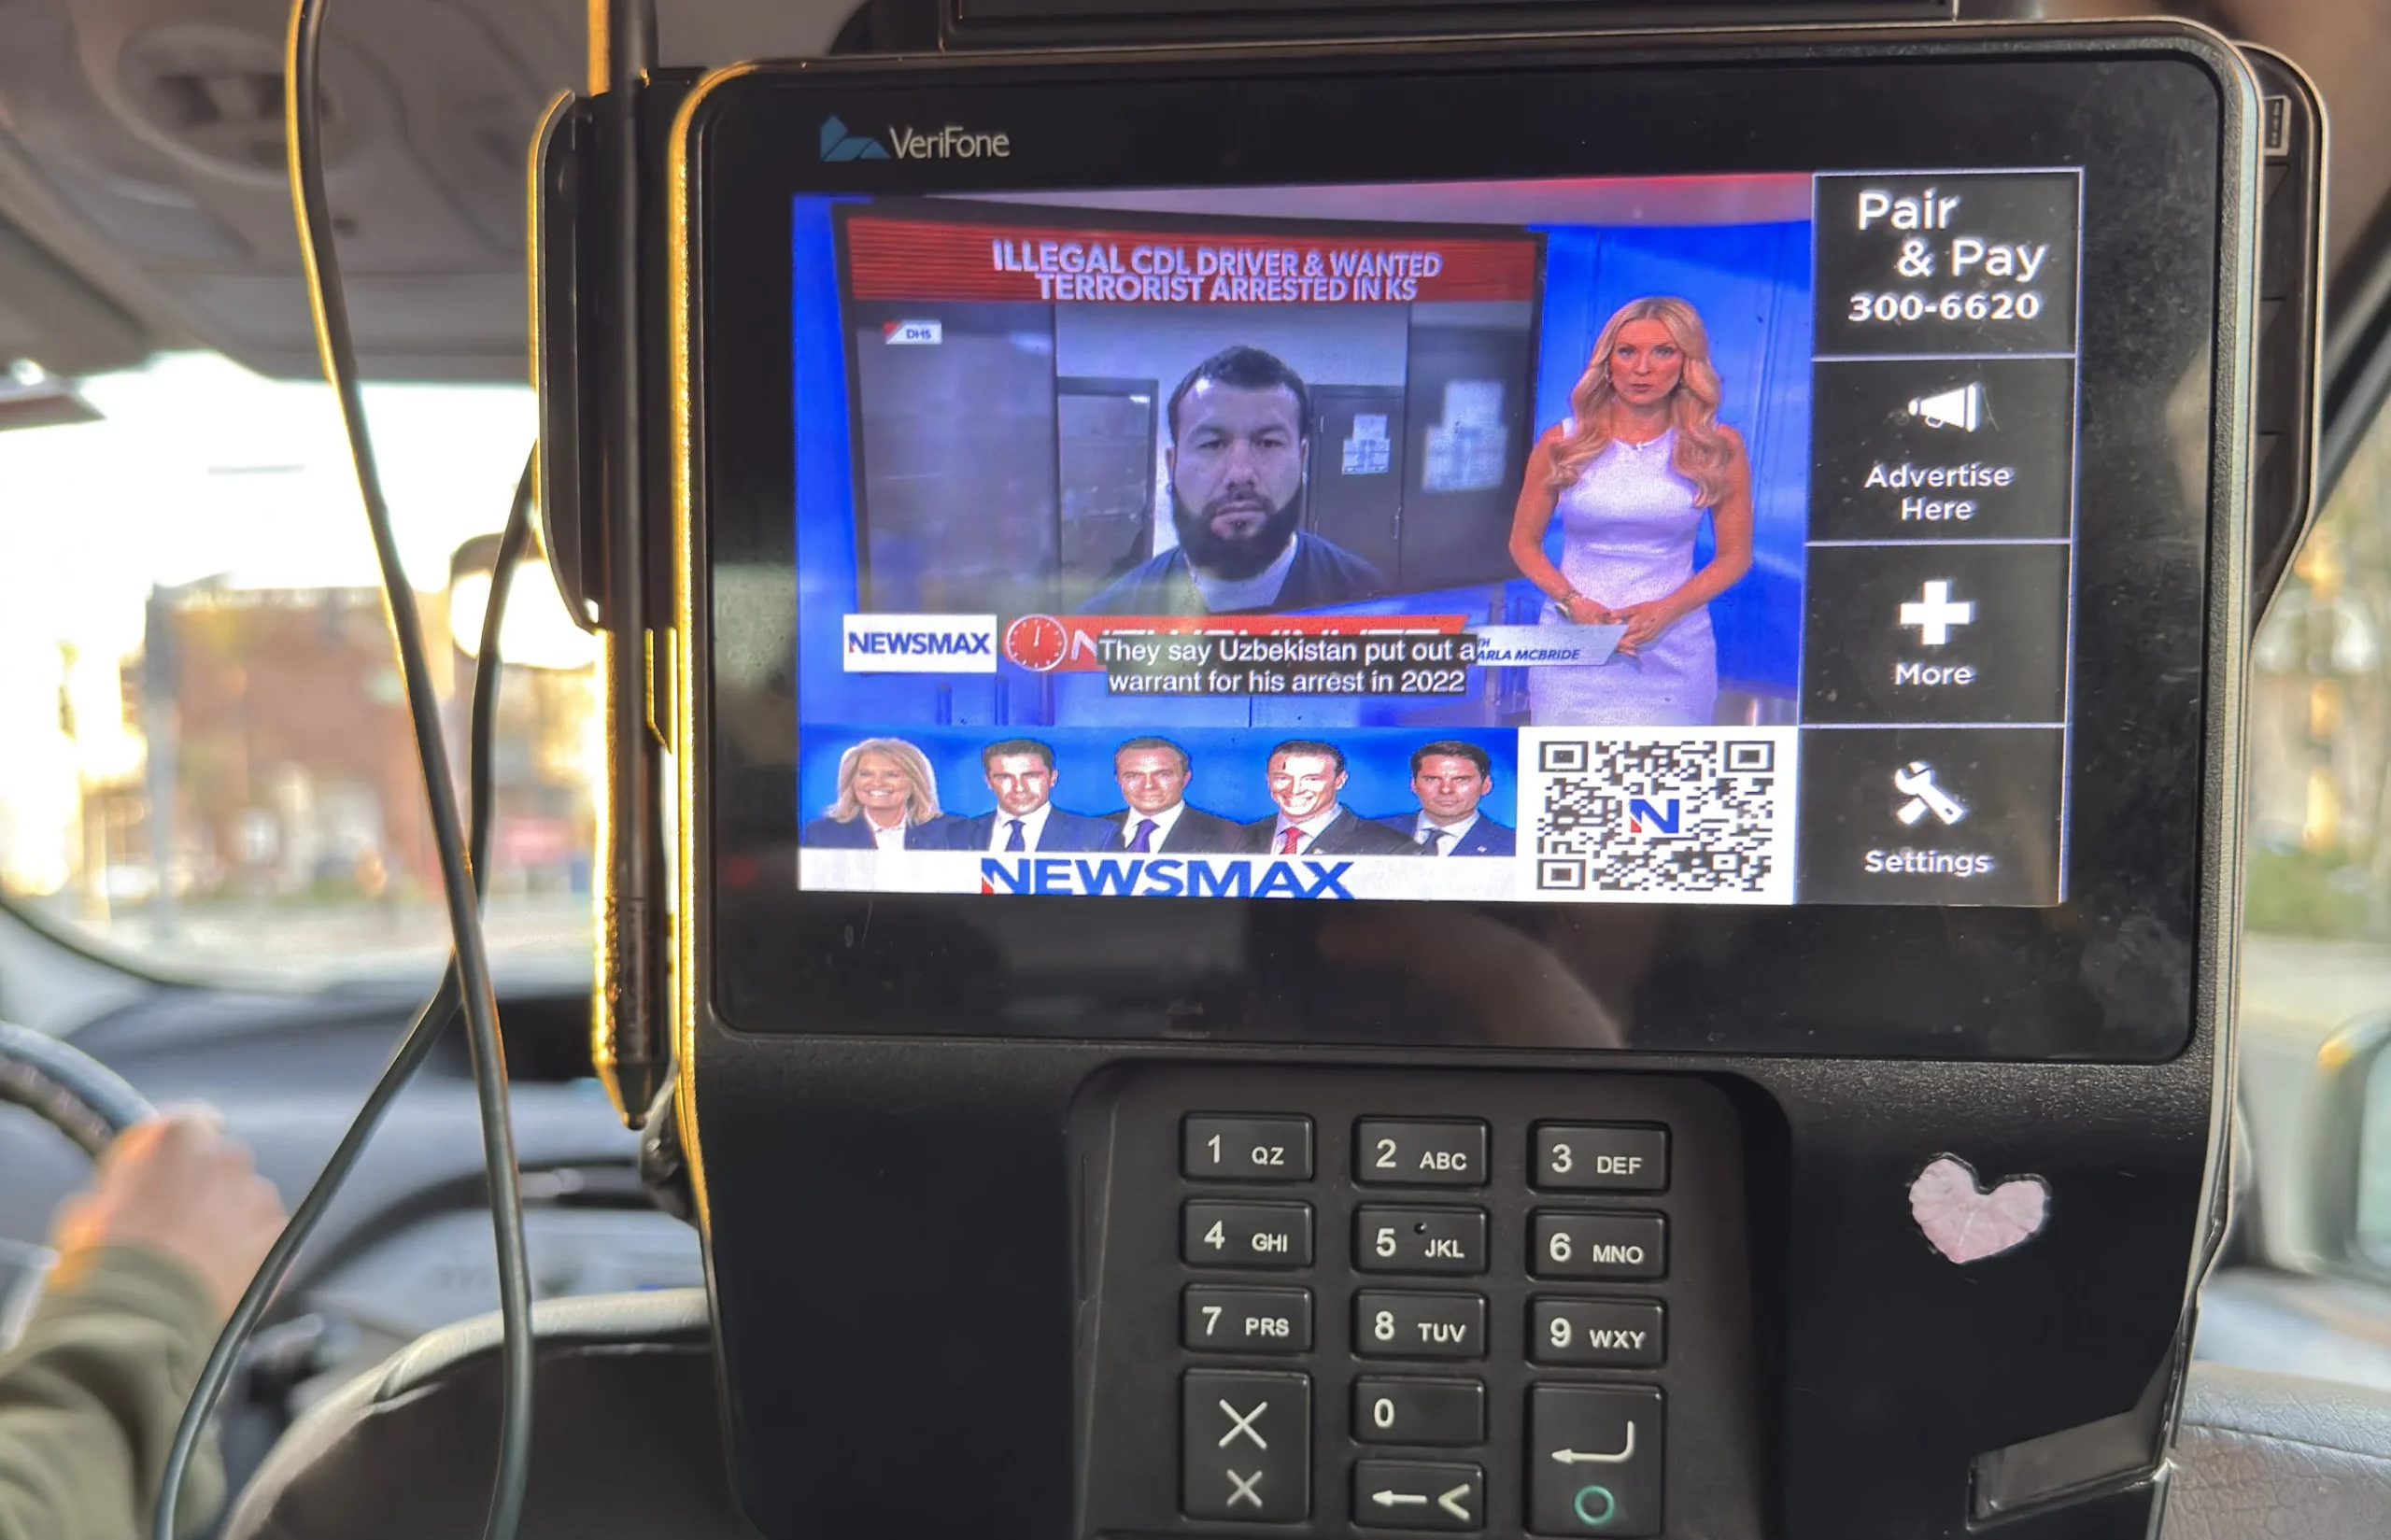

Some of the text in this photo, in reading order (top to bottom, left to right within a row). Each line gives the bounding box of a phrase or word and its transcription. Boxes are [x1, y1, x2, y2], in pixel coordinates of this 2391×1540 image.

[889, 124, 1011, 160] VeriFone
[1857, 188, 1961, 230] Pair
[992, 238, 1443, 278] ILLEGAL CDL DRIVER & WANTED
[1898, 237, 2047, 283] & Pay
[1035, 271, 1418, 302] TERRORIST ARRESTED IN KS
[1848, 293, 2041, 322] 300-6620
[906, 328, 932, 340] DHS
[1864, 464, 2014, 488] Advertise
[1901, 498, 1974, 520] Here
[848, 631, 991, 655] NEWSMAX
[1098, 638, 1161, 666] They
[1168, 643, 1212, 666] say
[1220, 638, 1357, 664] Uzbekistan
[1365, 642, 1406, 667] put
[1411, 642, 1452, 662] out
[1459, 644, 1477, 661] a
[1478, 649, 1580, 660] ARLA MCBRIDE
[1109, 670, 1465, 692] warrant for his arrest in 2022
[1896, 663, 1974, 685] More
[982, 856, 1355, 898] NEWSMAX
[1864, 849, 1995, 876] Settings
[1208, 1135, 1284, 1166] 1 QZ
[1376, 1138, 1467, 1171] 2 ABC
[1551, 1143, 1642, 1175] 3 DEF
[1204, 1221, 1287, 1253] 4 GHI
[1376, 1227, 1464, 1259] 5 JKL
[1549, 1233, 1644, 1264] 6 MNO
[1202, 1307, 1289, 1337] 7 PRS
[1375, 1311, 1465, 1343] 8 TUV
[1549, 1317, 1645, 1349] 9 WXY
[1373, 1398, 1394, 1428] 0
